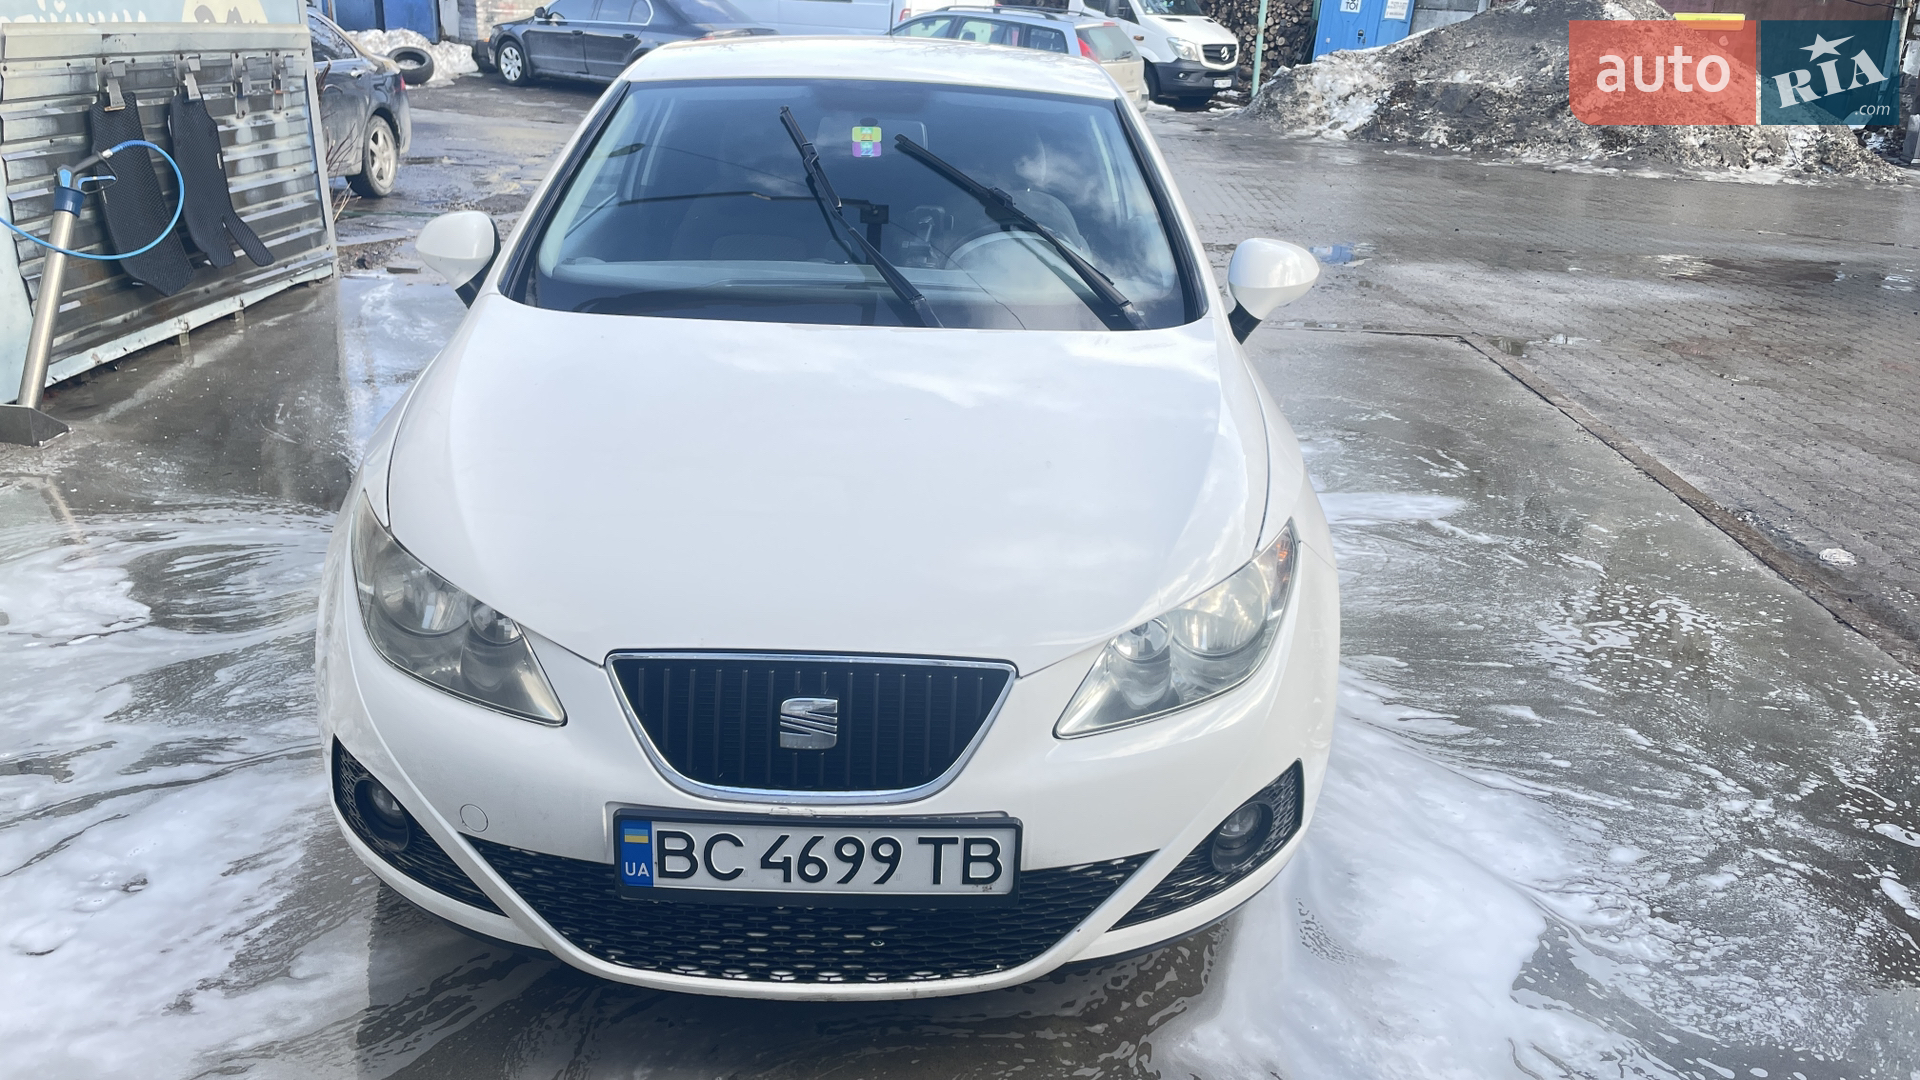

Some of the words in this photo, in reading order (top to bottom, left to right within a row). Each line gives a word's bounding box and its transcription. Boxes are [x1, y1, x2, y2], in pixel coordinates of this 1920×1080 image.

[625, 861, 650, 877] UA
[656, 830, 745, 881] BC
[760, 834, 903, 885] 4699
[917, 836, 1003, 885] TB
